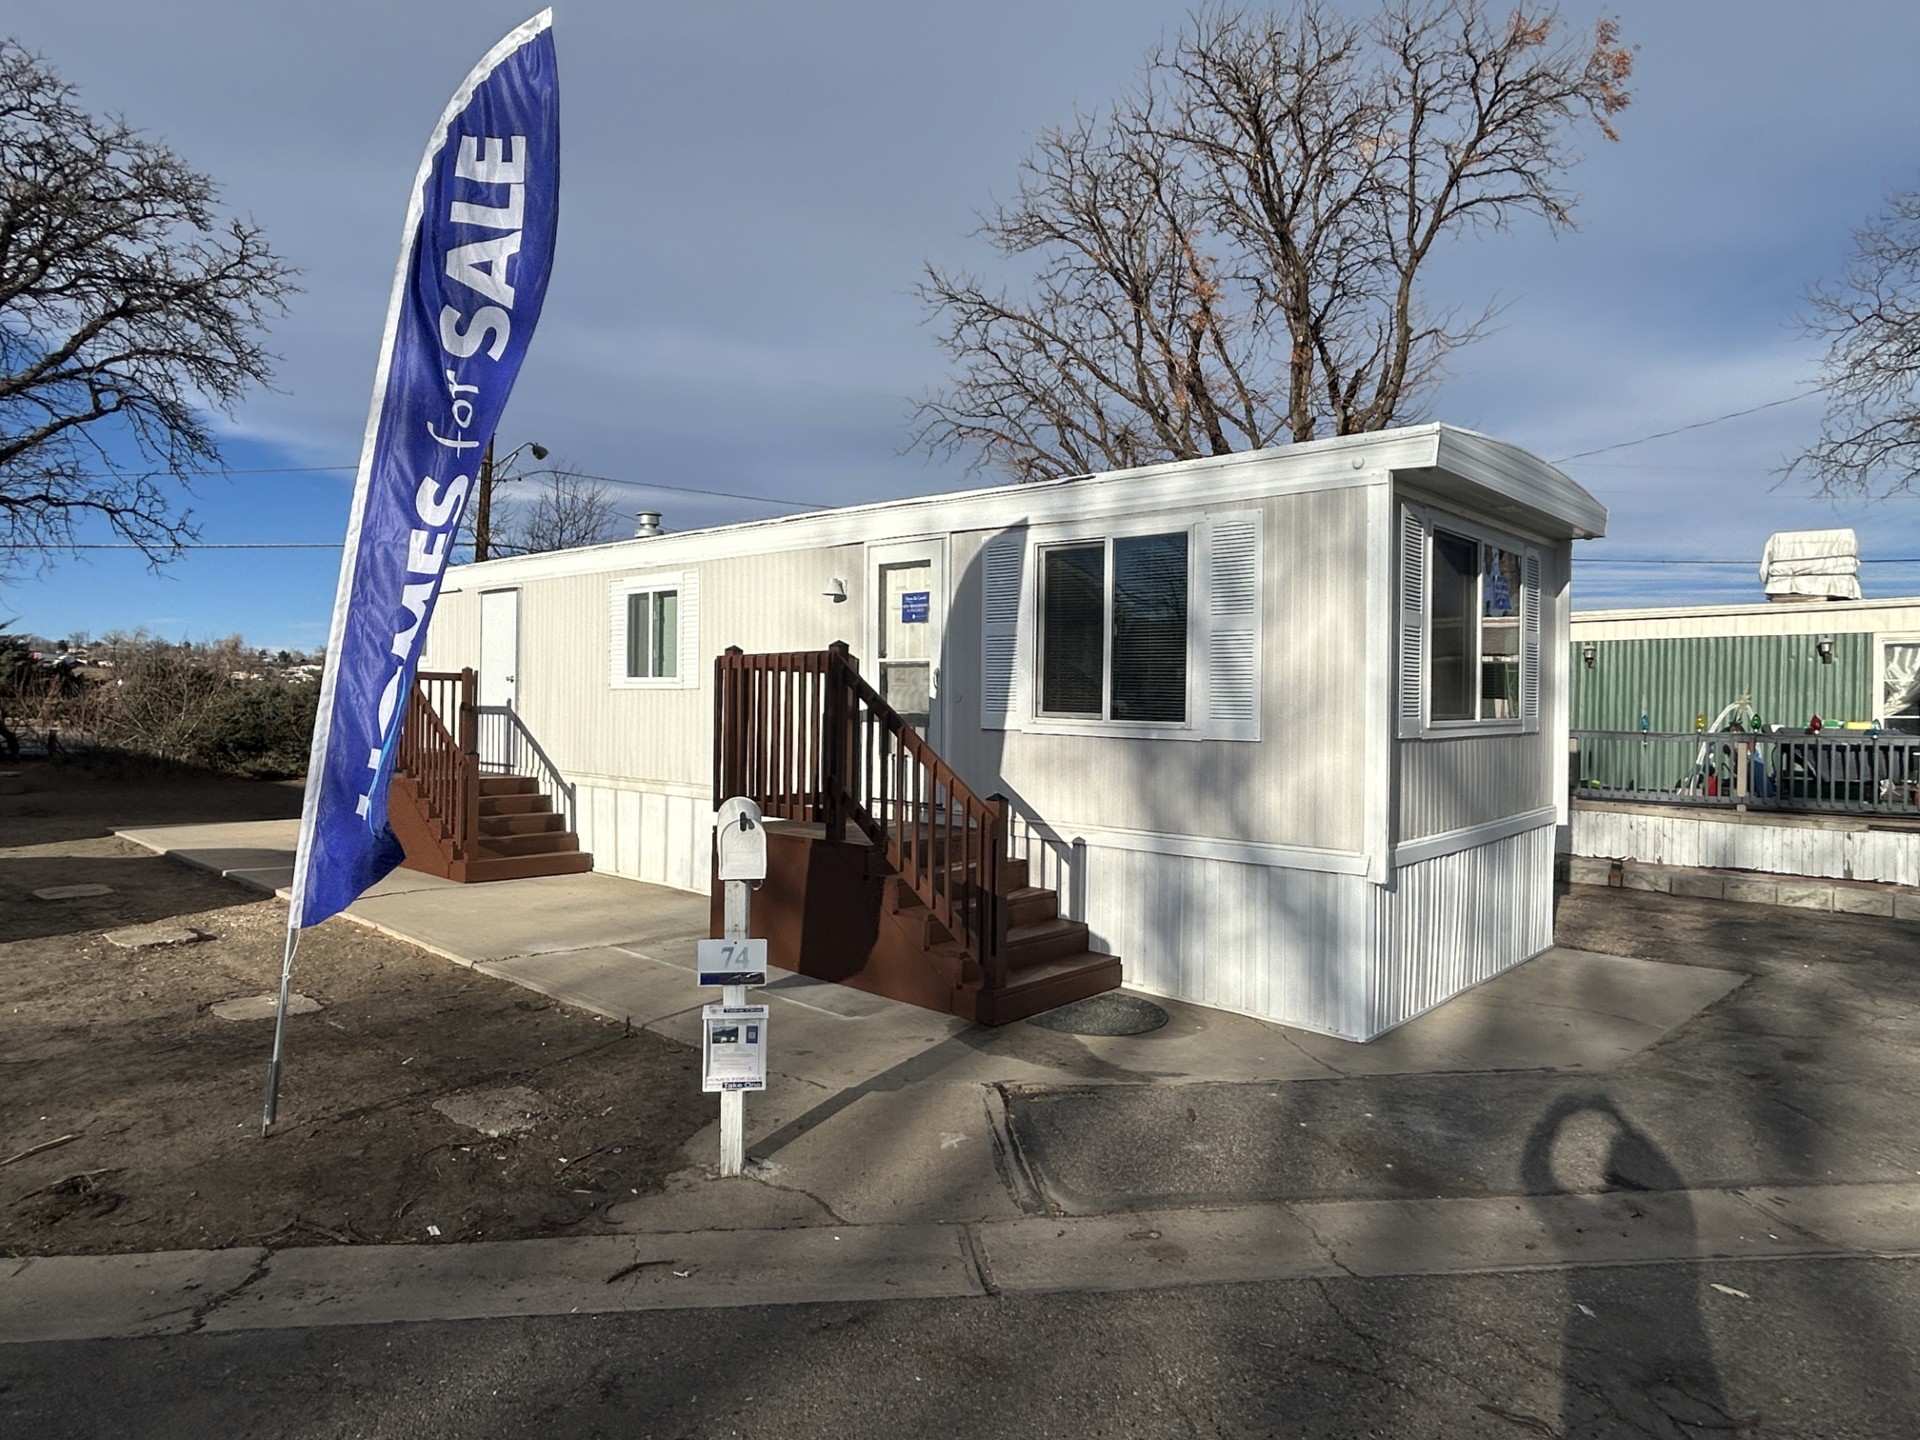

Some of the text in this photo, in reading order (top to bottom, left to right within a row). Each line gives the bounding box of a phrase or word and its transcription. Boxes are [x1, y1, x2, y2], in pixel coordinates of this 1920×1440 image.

[439, 134, 527, 363] SALE
[427, 368, 480, 459] for
[720, 946, 750, 969] 74
